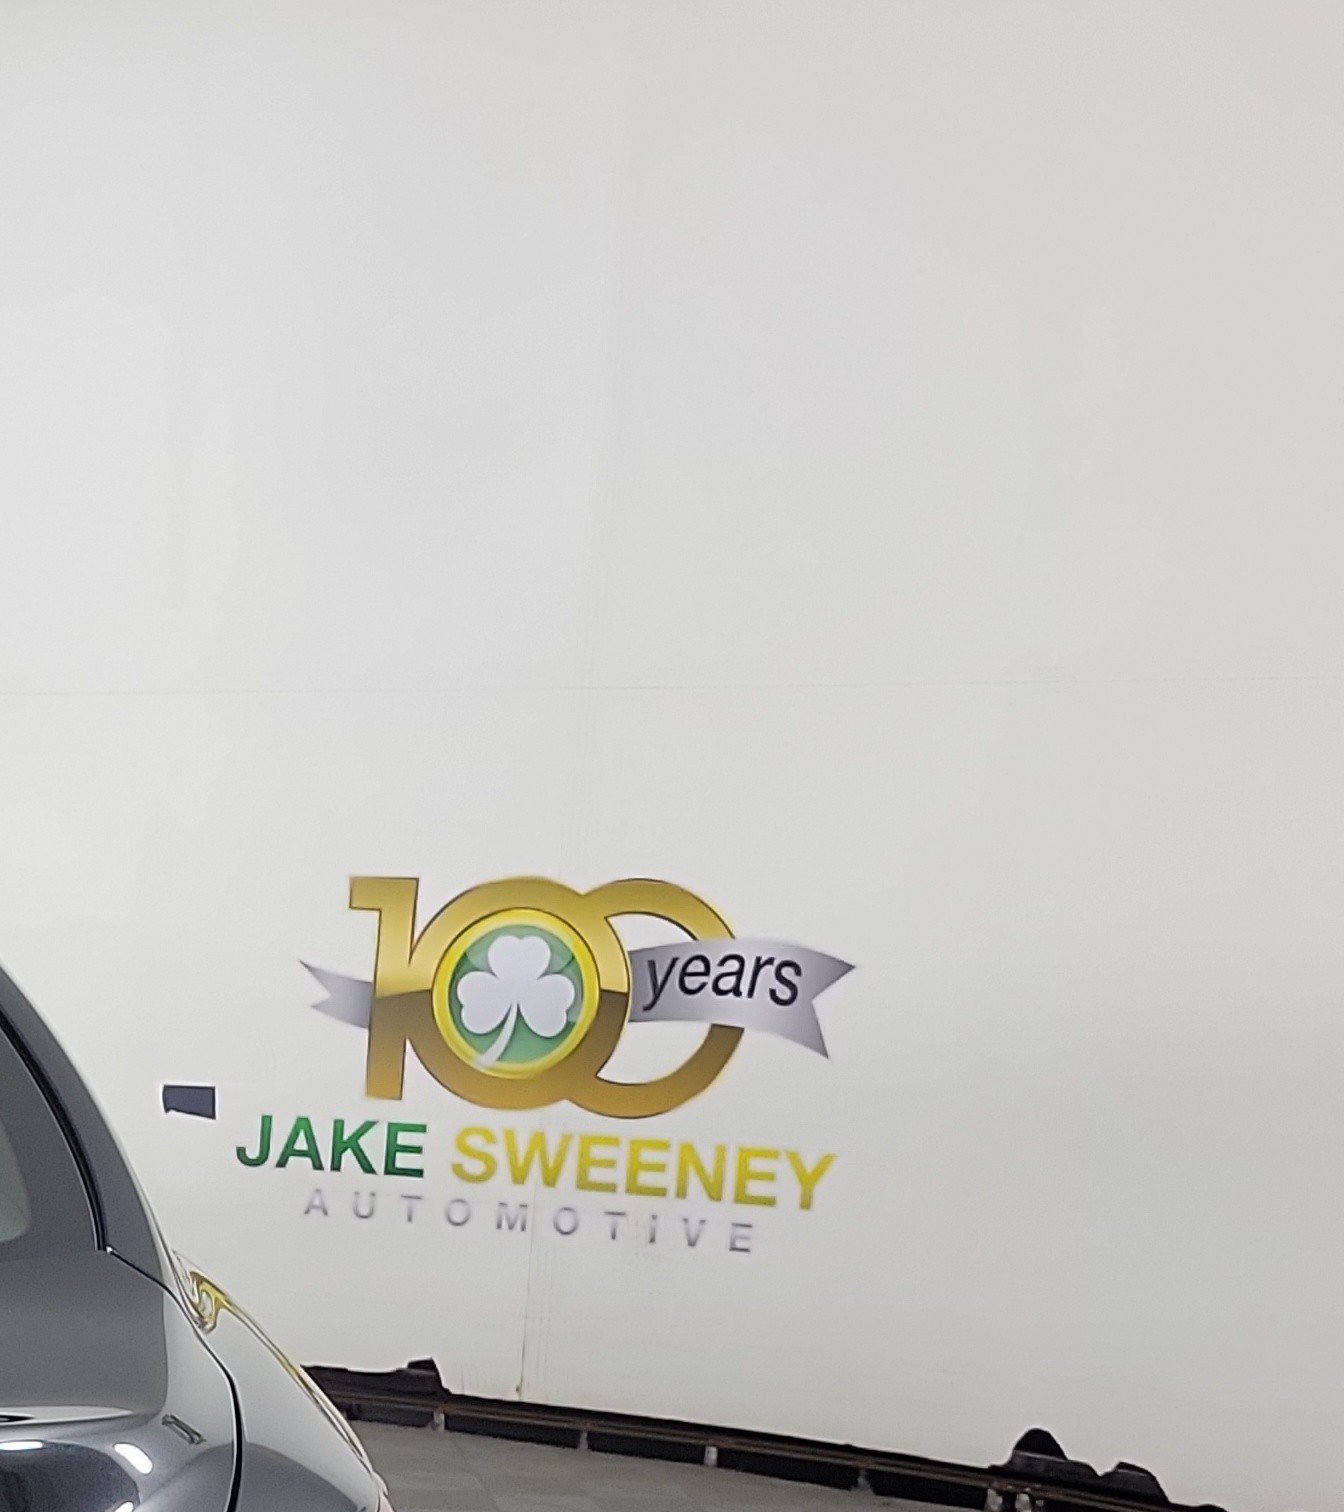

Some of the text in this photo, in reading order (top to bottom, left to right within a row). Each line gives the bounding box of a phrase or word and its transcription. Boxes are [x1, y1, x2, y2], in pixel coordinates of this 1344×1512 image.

[348, 876, 805, 1119] 100 years
[235, 1114, 838, 1212] JAKE SWEENEY
[303, 1187, 755, 1254] AUTOMOTIVE
